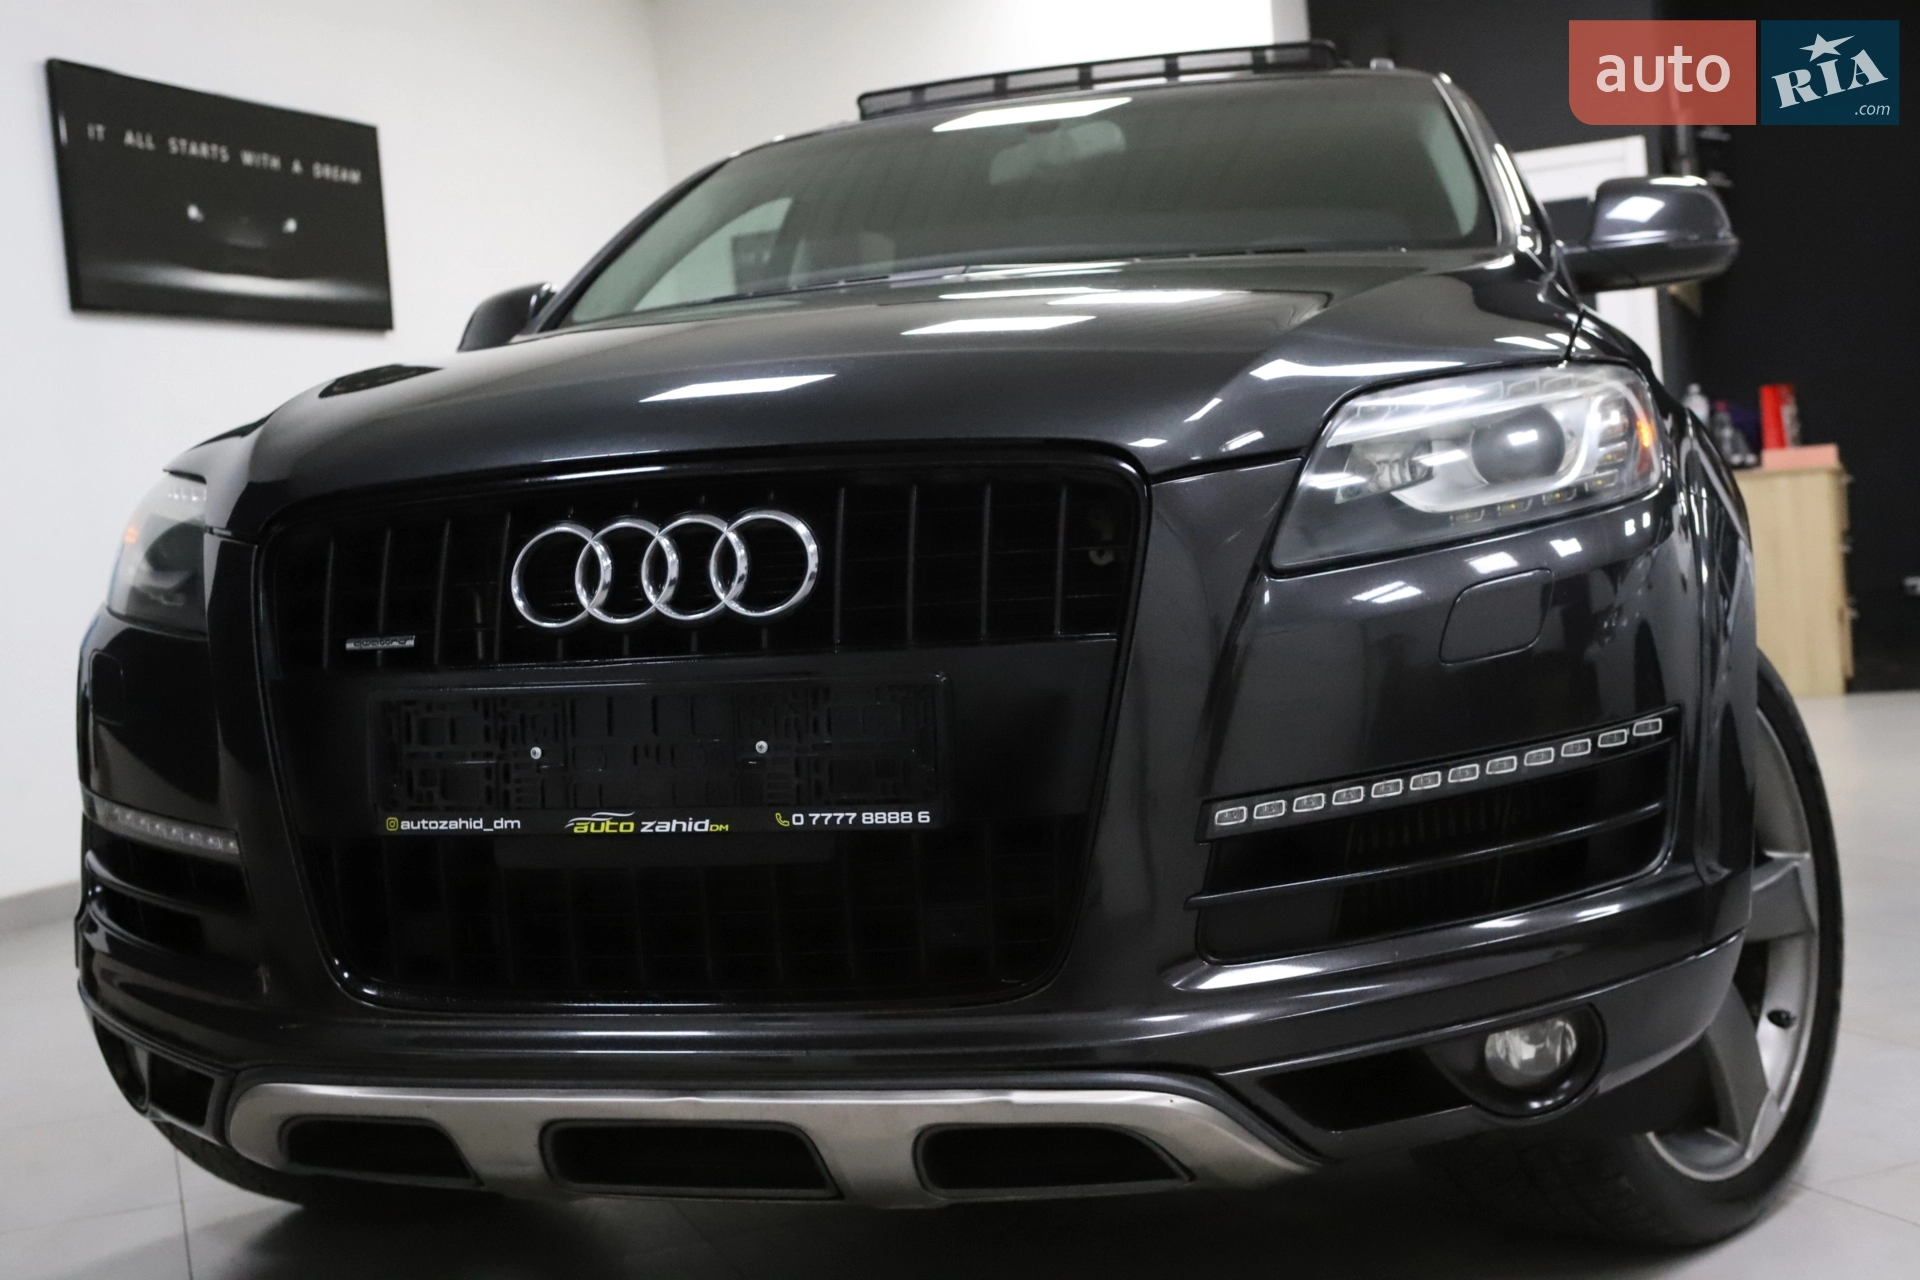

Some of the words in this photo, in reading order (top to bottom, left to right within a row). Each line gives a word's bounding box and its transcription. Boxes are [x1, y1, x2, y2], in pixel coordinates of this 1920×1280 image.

[87, 122, 106, 141] IT
[123, 129, 155, 151] ALL
[168, 136, 230, 162] STARTS
[240, 149, 281, 172] WITH
[291, 158, 304, 175] A
[311, 161, 362, 184] DREAM
[400, 817, 521, 832] autozahid_dm
[792, 813, 804, 826] 0
[808, 812, 857, 826] 7777
[861, 811, 913, 825] 8888
[917, 811, 931, 824] 6
[573, 819, 635, 834] auto
